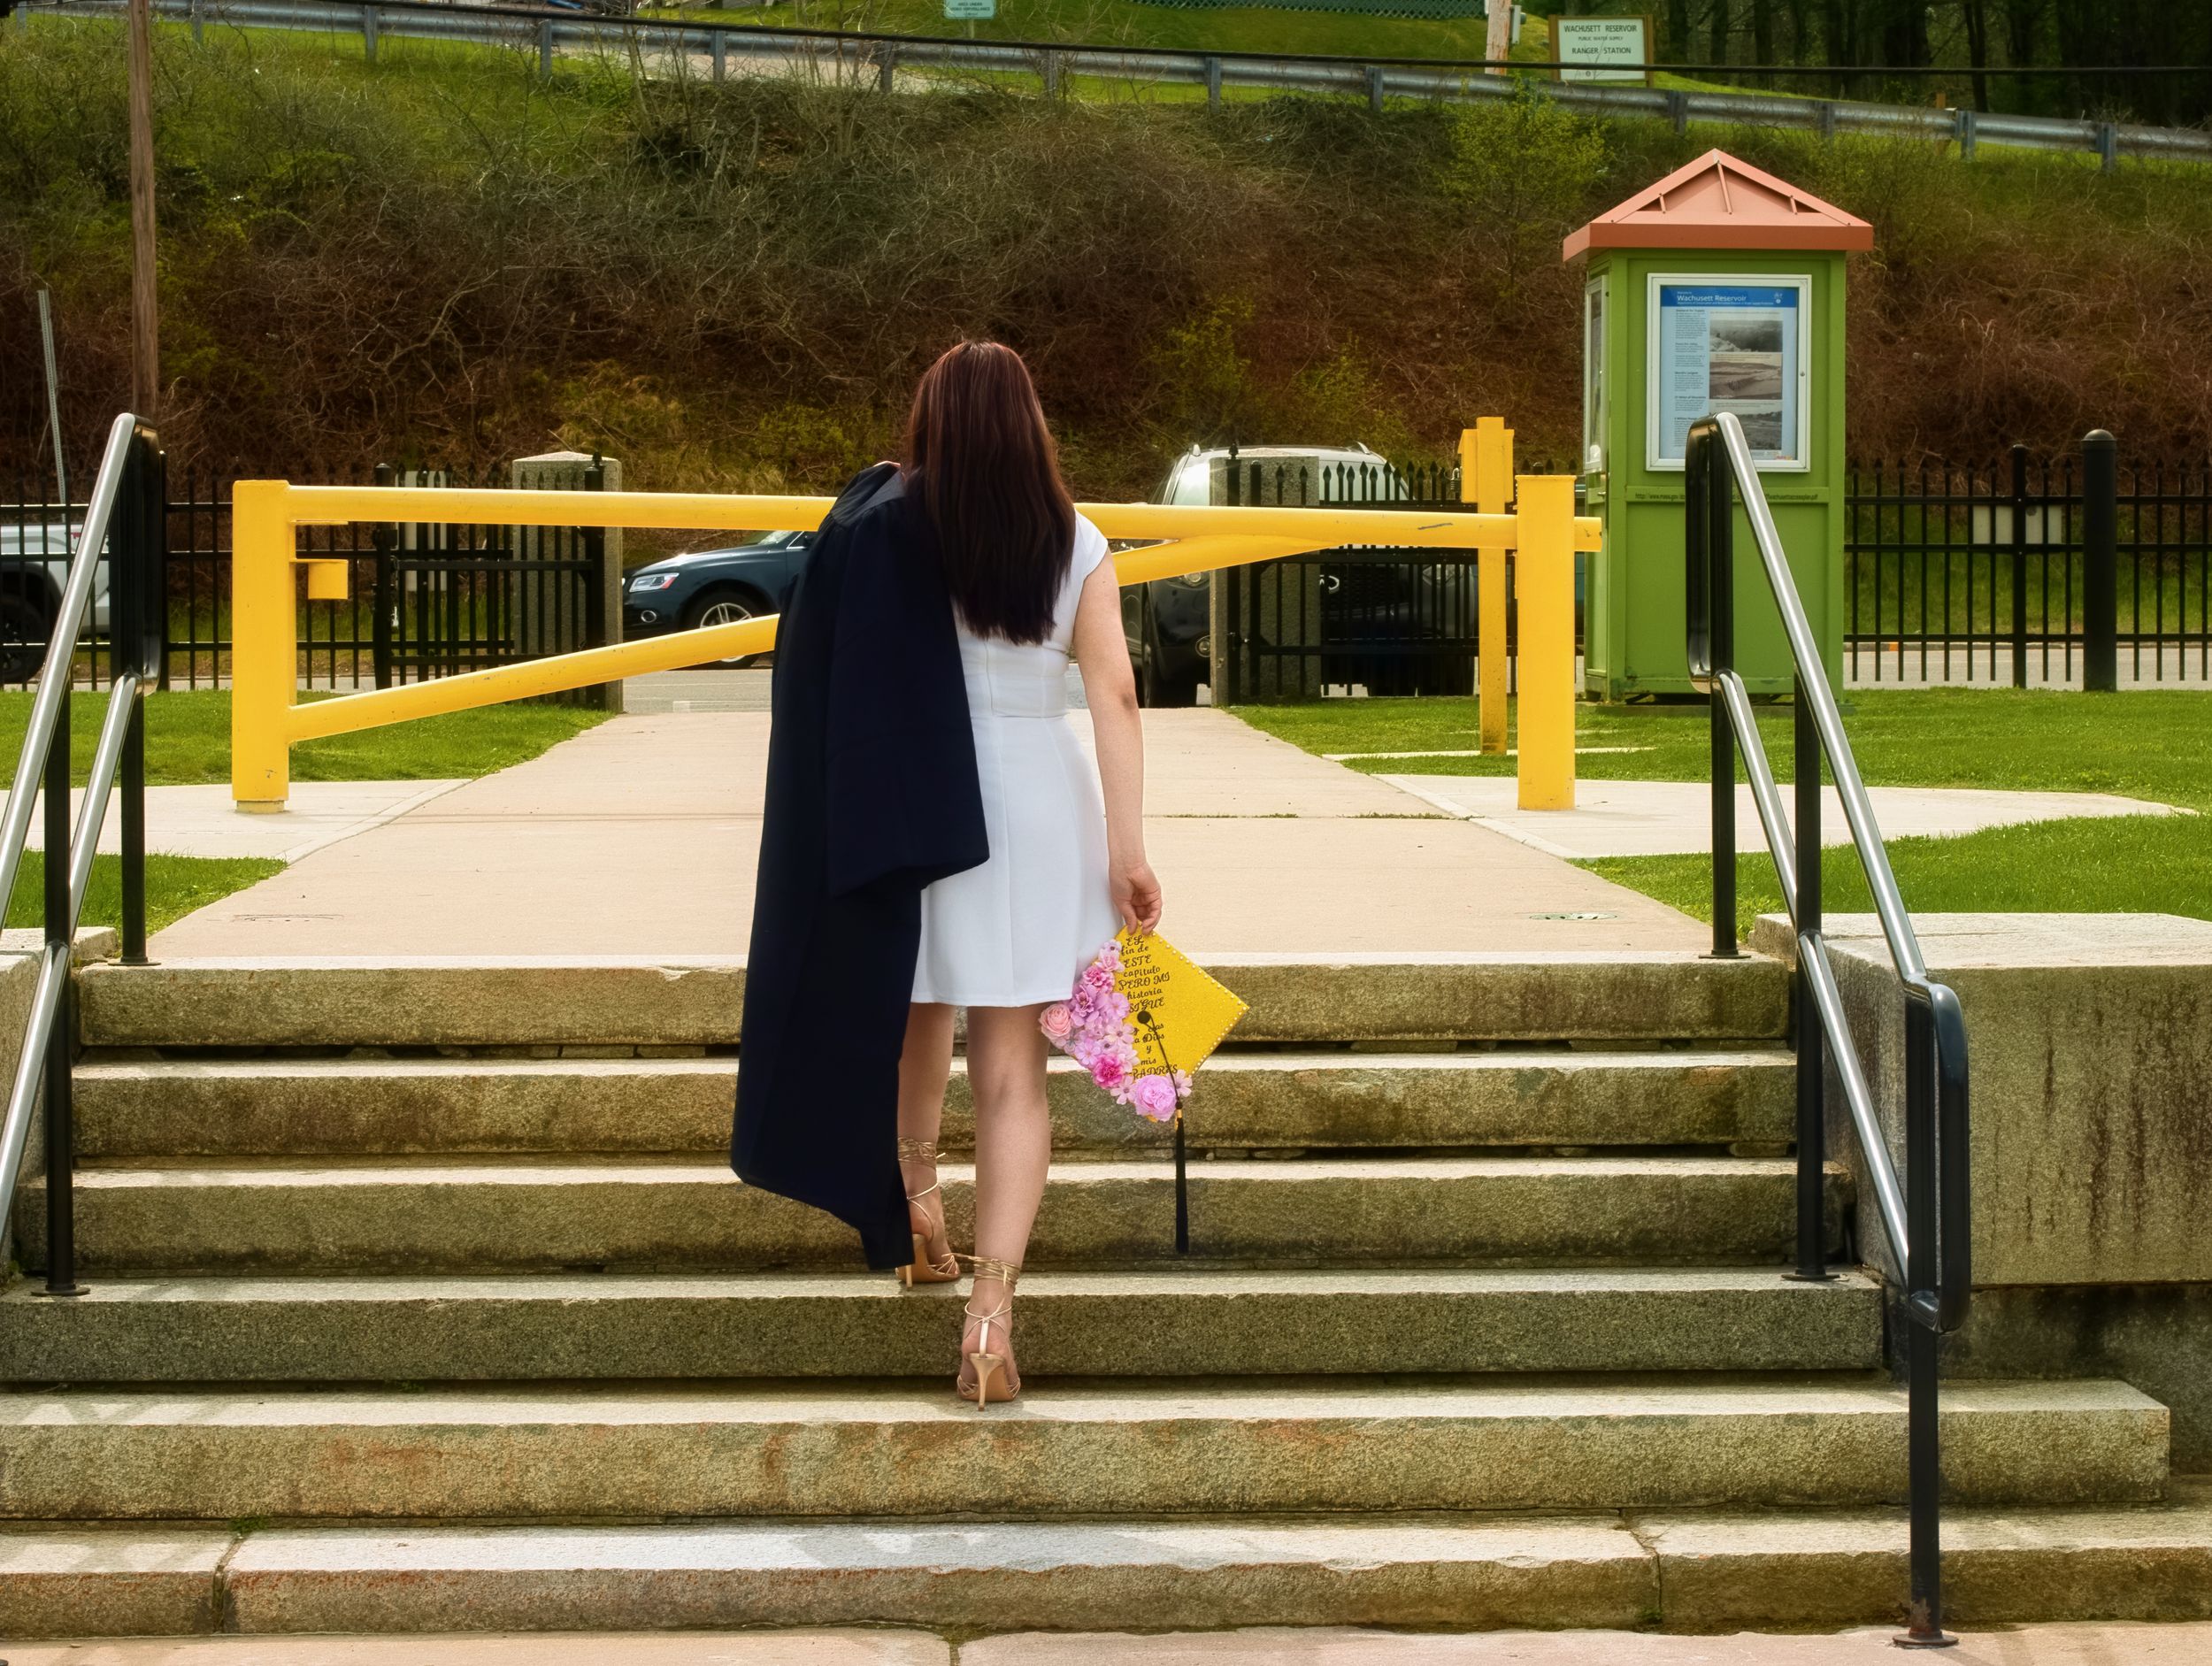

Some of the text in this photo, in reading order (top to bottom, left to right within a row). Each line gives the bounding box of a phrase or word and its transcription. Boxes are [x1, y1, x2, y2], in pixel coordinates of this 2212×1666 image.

[1126, 935, 1144, 946] EL
[1124, 955, 1151, 968] ESTE
[1118, 971, 1170, 991] PERO MI
[1127, 987, 1163, 1000] historia
[1128, 997, 1164, 1013] SIGUE
[1147, 1045, 1151, 1054] y
[1133, 1064, 1178, 1080] PADRES
